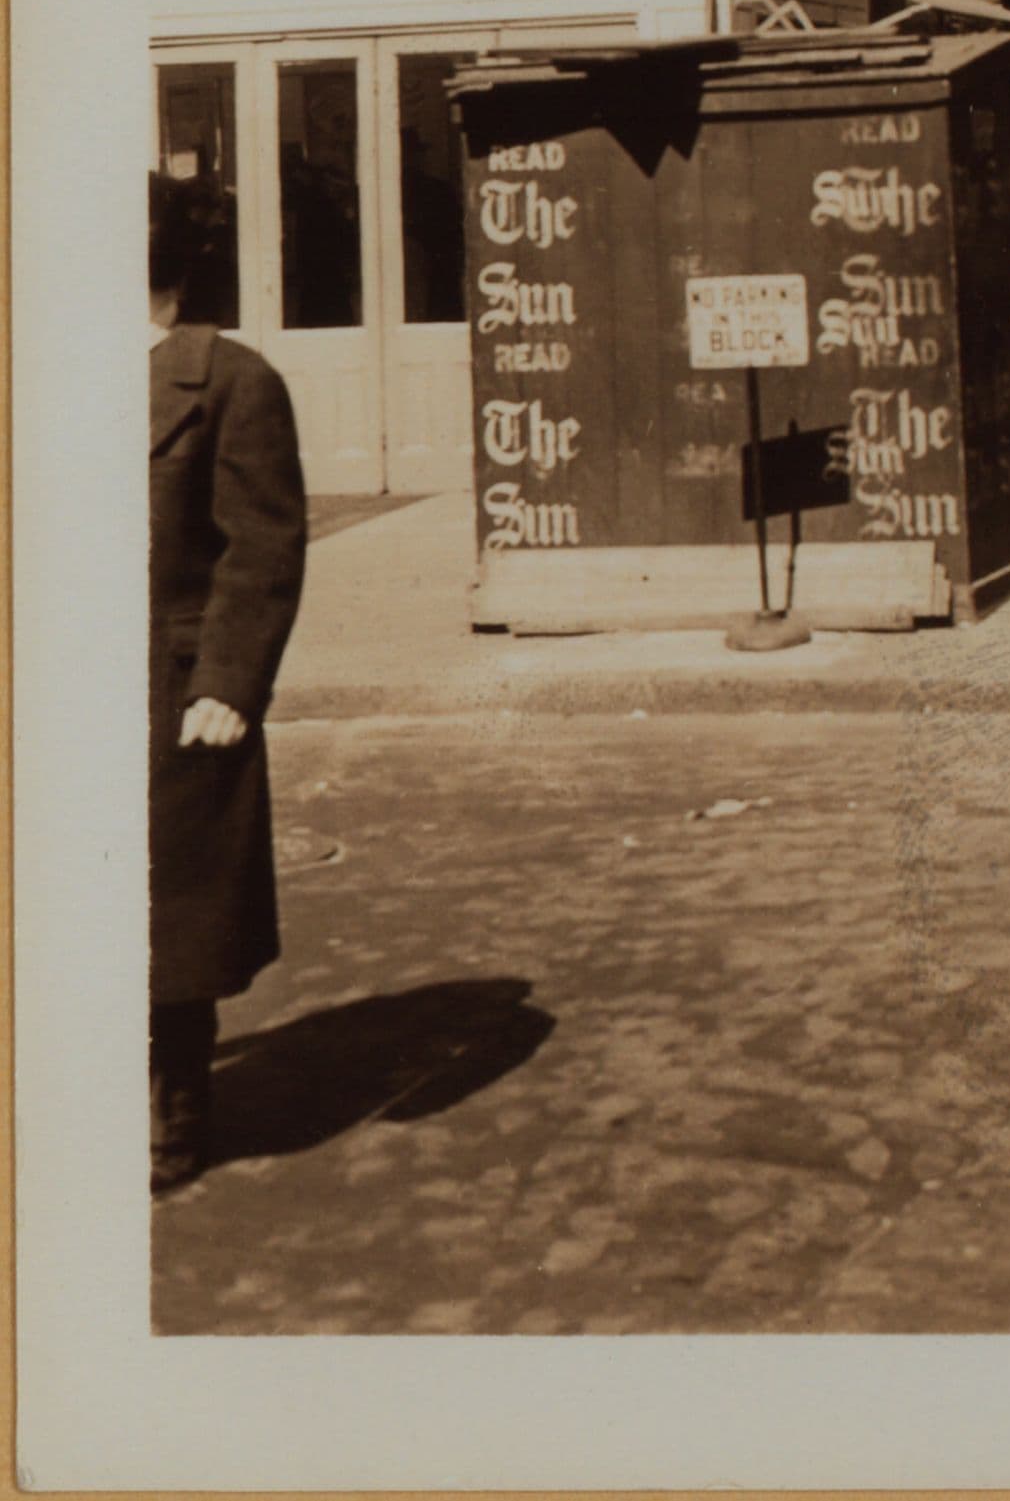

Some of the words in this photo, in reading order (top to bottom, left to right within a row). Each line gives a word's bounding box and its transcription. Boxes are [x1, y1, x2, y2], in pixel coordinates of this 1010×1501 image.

[488, 141, 566, 173] READ
[841, 114, 921, 144] READ
[478, 178, 579, 249] The
[477, 261, 578, 335] Sun
[840, 253, 944, 319] Sun
[494, 342, 571, 373] READ
[709, 328, 790, 353] BLOCK
[482, 399, 582, 470] The
[850, 387, 953, 460] The
[483, 482, 581, 549] Sun
[856, 476, 961, 537] Sun
